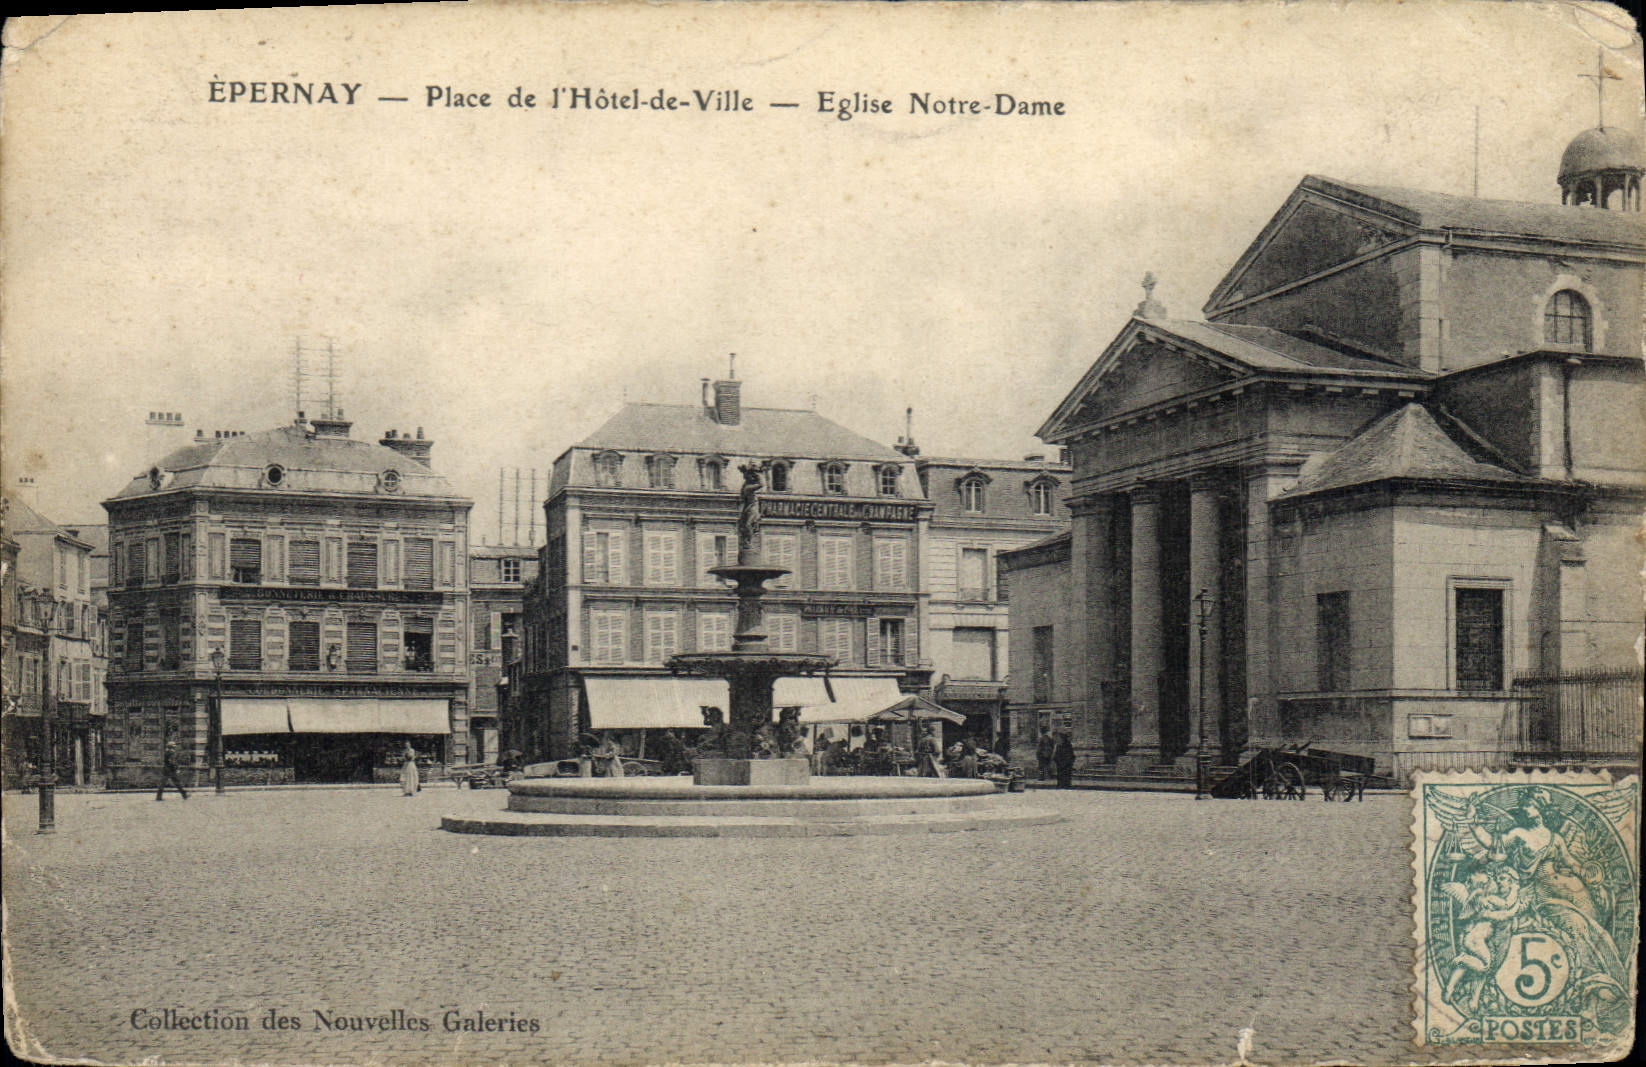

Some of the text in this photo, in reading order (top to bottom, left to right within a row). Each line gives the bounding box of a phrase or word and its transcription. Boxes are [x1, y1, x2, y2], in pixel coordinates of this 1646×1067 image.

[760, 501, 810, 516] PHARMACIE
[810, 502, 855, 518] CENTRALE
[1485, 1019, 1578, 1041] POSTES
